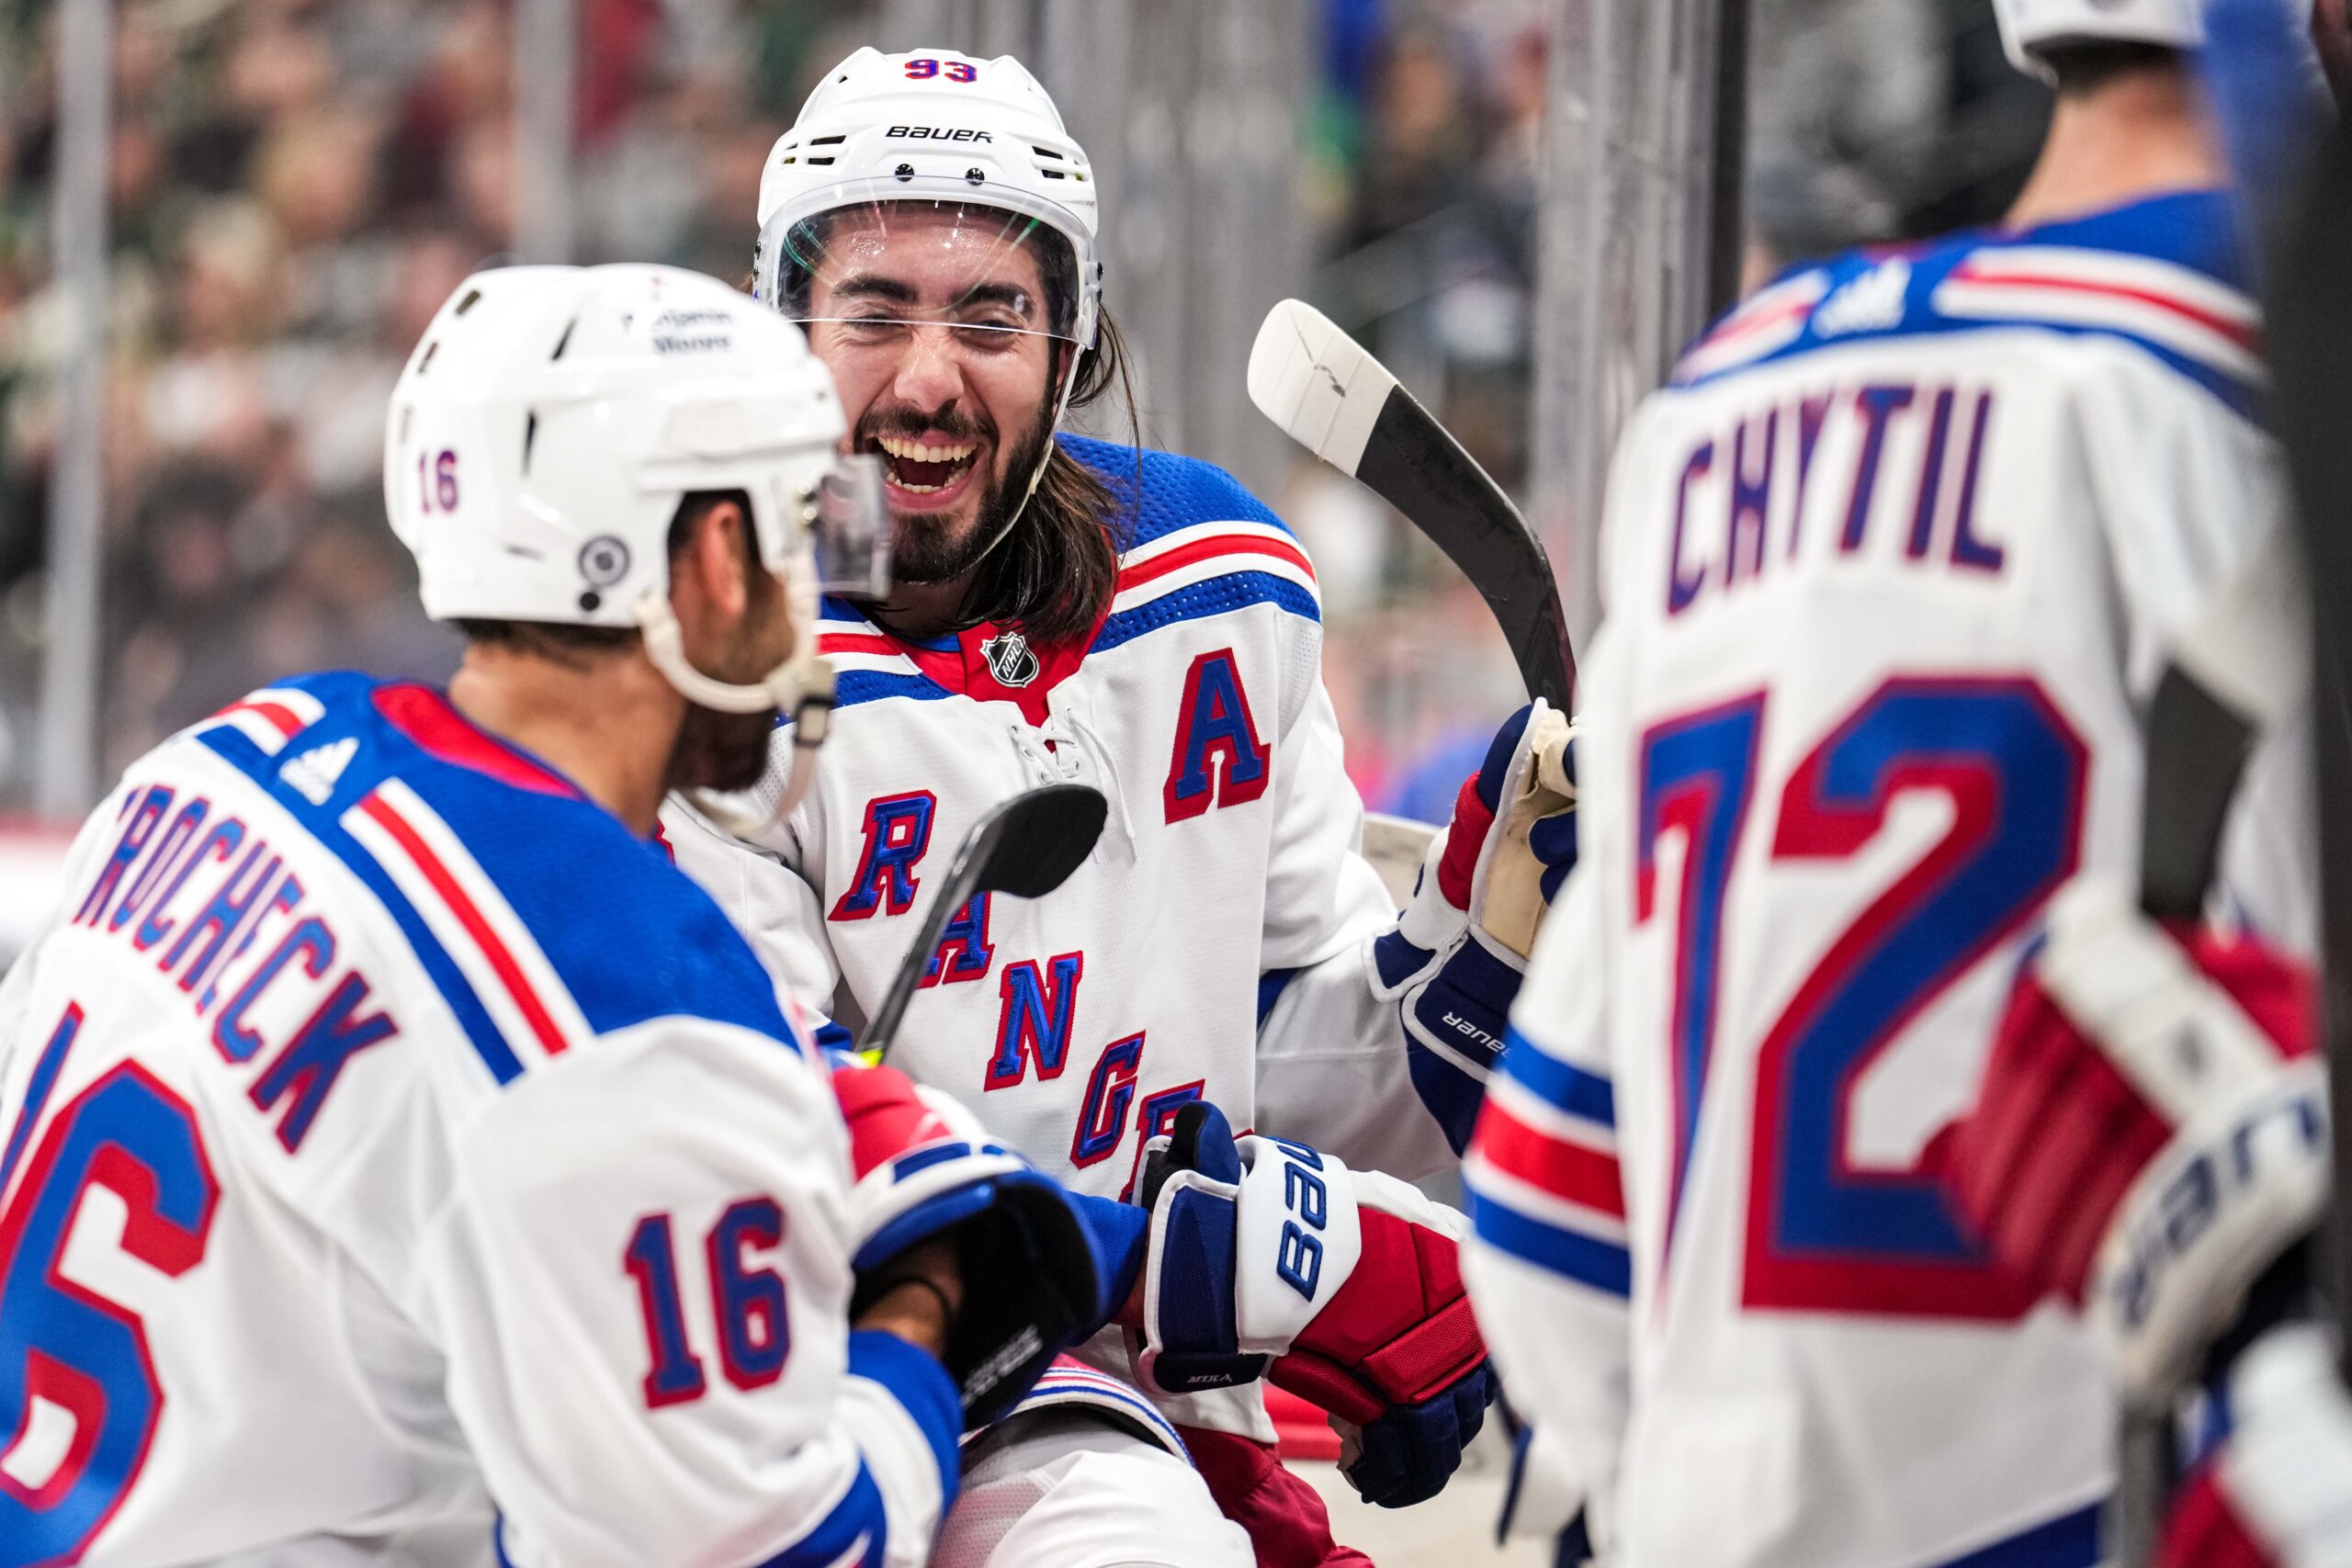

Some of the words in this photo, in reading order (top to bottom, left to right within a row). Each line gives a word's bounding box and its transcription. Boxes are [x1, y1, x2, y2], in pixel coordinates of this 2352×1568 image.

[904, 58, 978, 84] 93
[885, 125, 995, 145] BAUER
[418, 449, 460, 514] 16
[1664, 383, 2008, 619] CHYTIL
[1001, 645, 1023, 679] NHL
[1162, 646, 1272, 825] A
[1631, 673, 2093, 1327] 72
[622, 1190, 793, 1410] 16
[1186, 1372, 1233, 1383] MIKA
